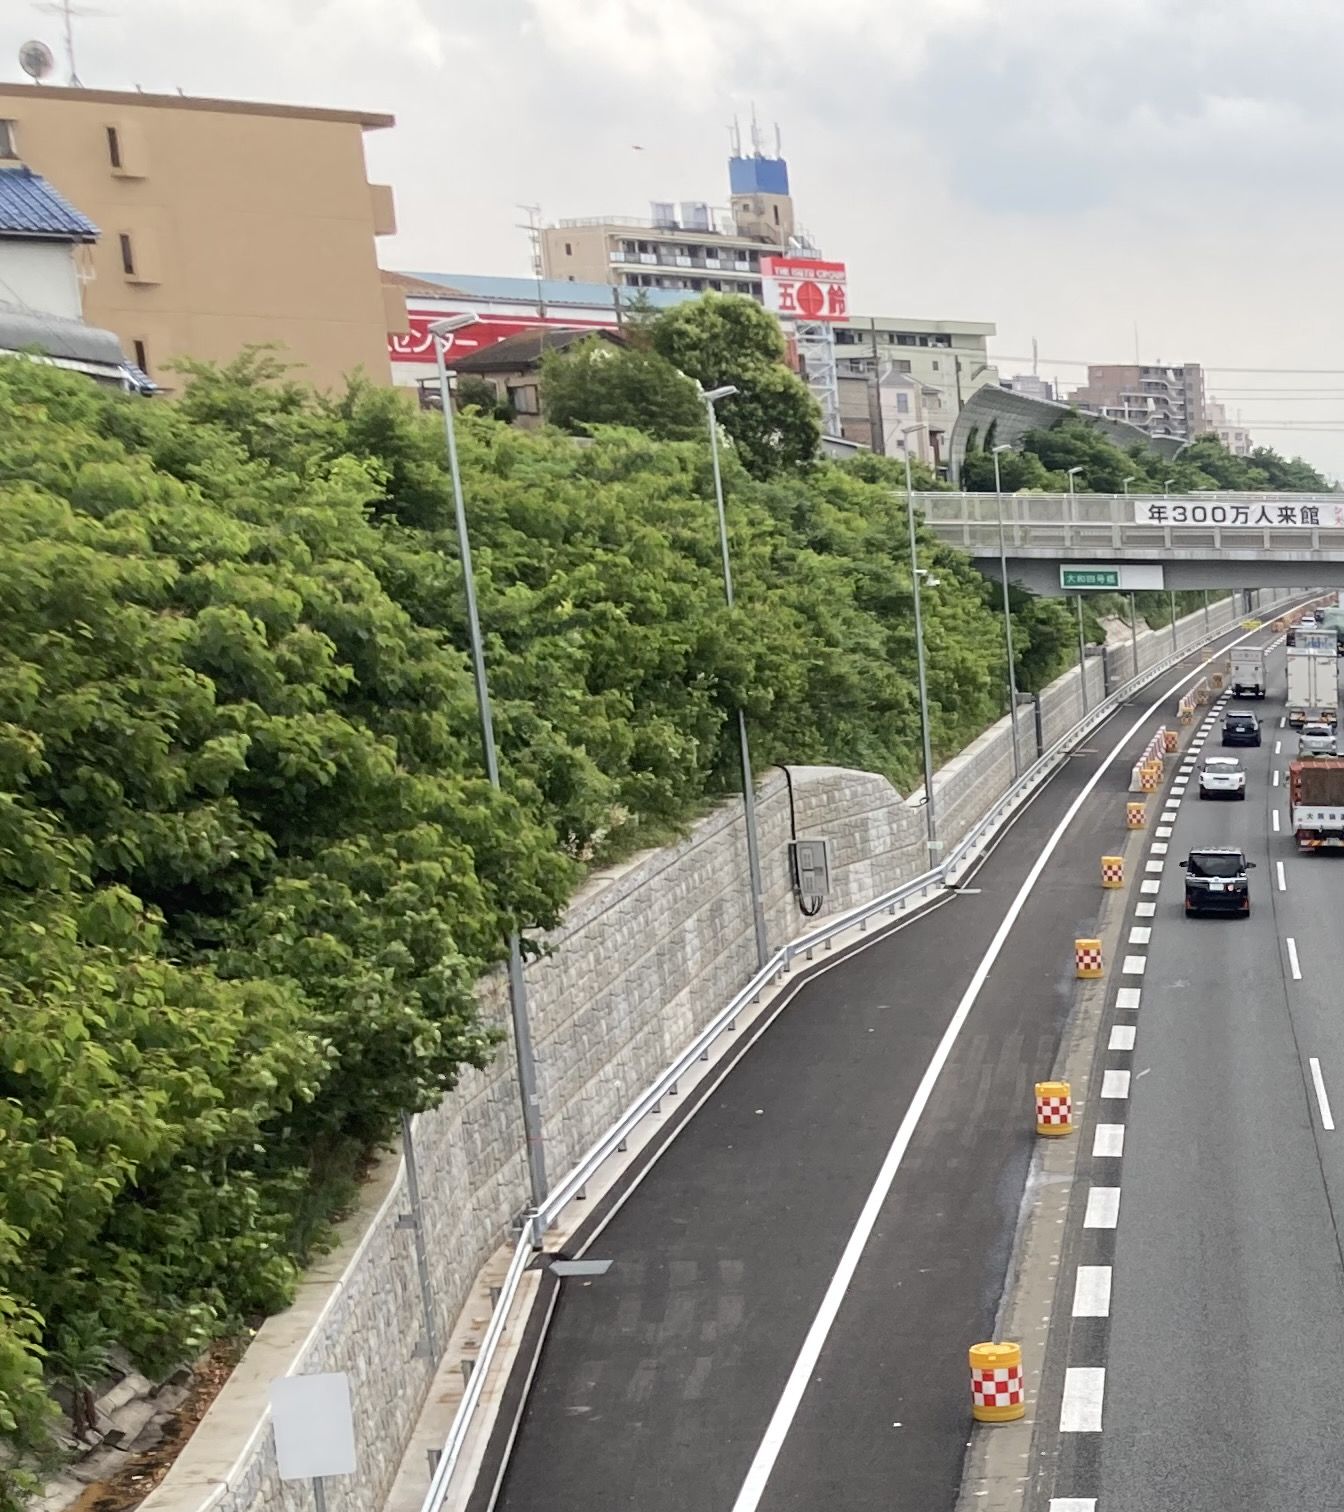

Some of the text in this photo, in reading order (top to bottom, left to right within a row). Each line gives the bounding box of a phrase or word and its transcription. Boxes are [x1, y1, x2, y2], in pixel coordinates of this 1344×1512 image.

[1148, 504, 1320, 525] 年300万人来館
